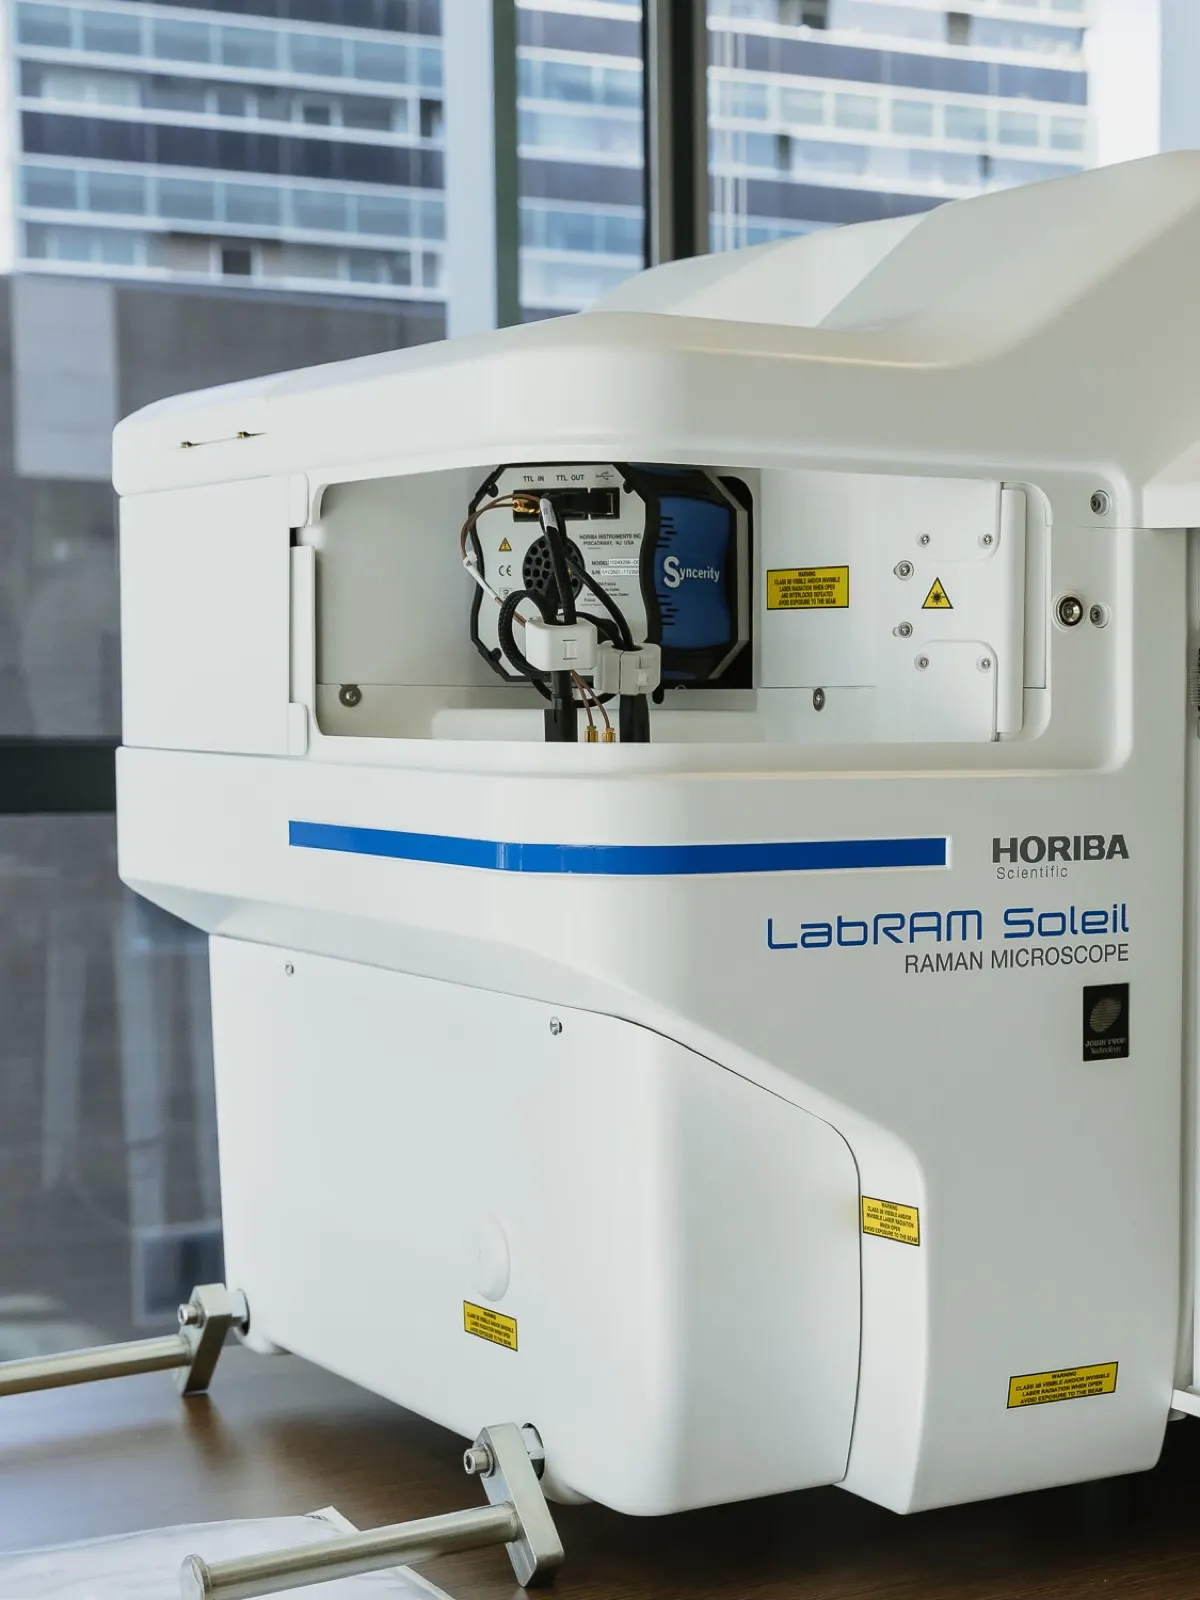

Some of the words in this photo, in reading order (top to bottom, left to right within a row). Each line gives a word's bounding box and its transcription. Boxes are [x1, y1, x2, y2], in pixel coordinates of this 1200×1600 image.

[556, 474, 568, 482] TTL
[663, 555, 720, 588] Syncerity
[992, 834, 1129, 863] HORIBA
[996, 865, 1068, 880] Scientific
[767, 909, 982, 950] LabRAM
[1003, 902, 1129, 939] Soleil
[904, 950, 983, 974] RAMAN
[990, 943, 1129, 969] MICROSCOPE
[1042, 1379, 1062, 1388] VISIBLE
[1064, 1376, 1084, 1384] AND/OR
[1085, 1372, 1110, 1381] INVISIBLE
[1051, 1371, 1077, 1379] WARNING
[1041, 1386, 1070, 1395] RADIATION
[1071, 1383, 1087, 1391] WHEN
[1087, 1380, 1103, 1388] OPEN
[1038, 1392, 1066, 1401] EXPOSURE
